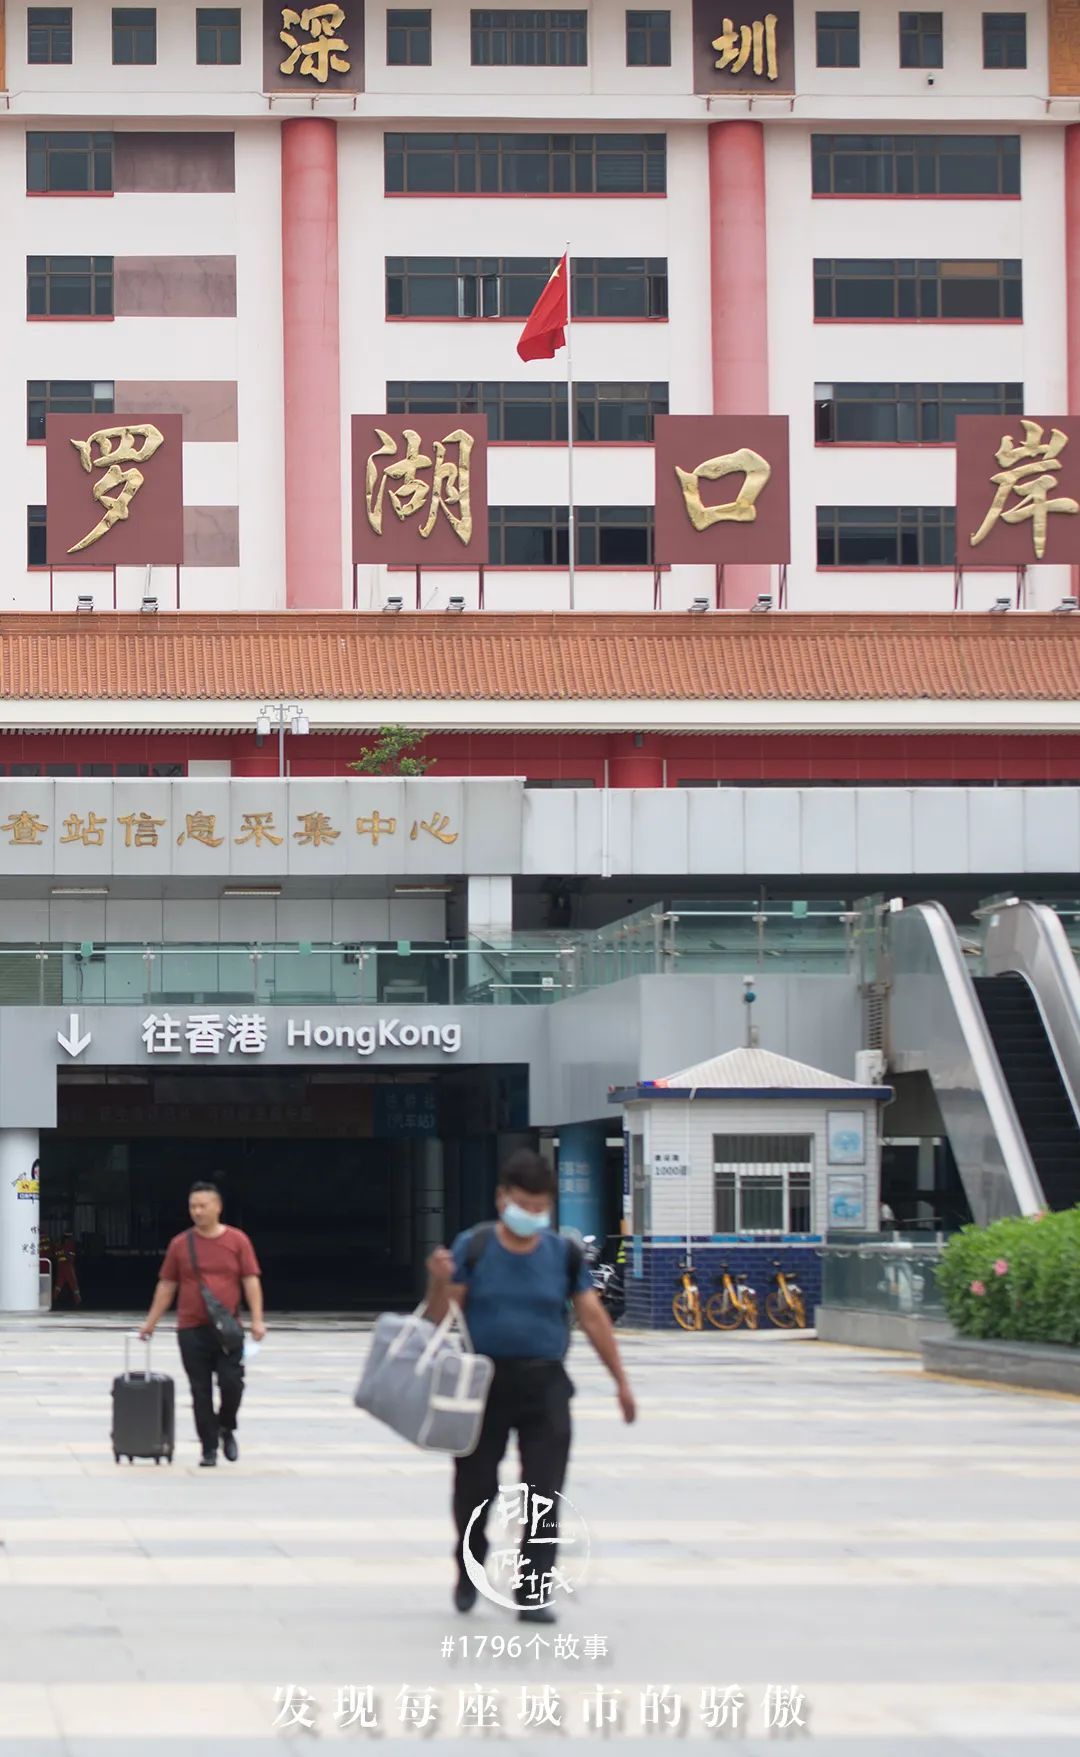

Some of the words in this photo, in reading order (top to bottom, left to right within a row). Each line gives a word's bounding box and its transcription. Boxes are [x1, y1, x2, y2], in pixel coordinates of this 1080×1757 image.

[68, 420, 1079, 557] 罗湖口岸
[1, 811, 459, 847] 查站信息采集中心
[142, 1013, 267, 1055] 往香港
[287, 1018, 462, 1055] HongKong
